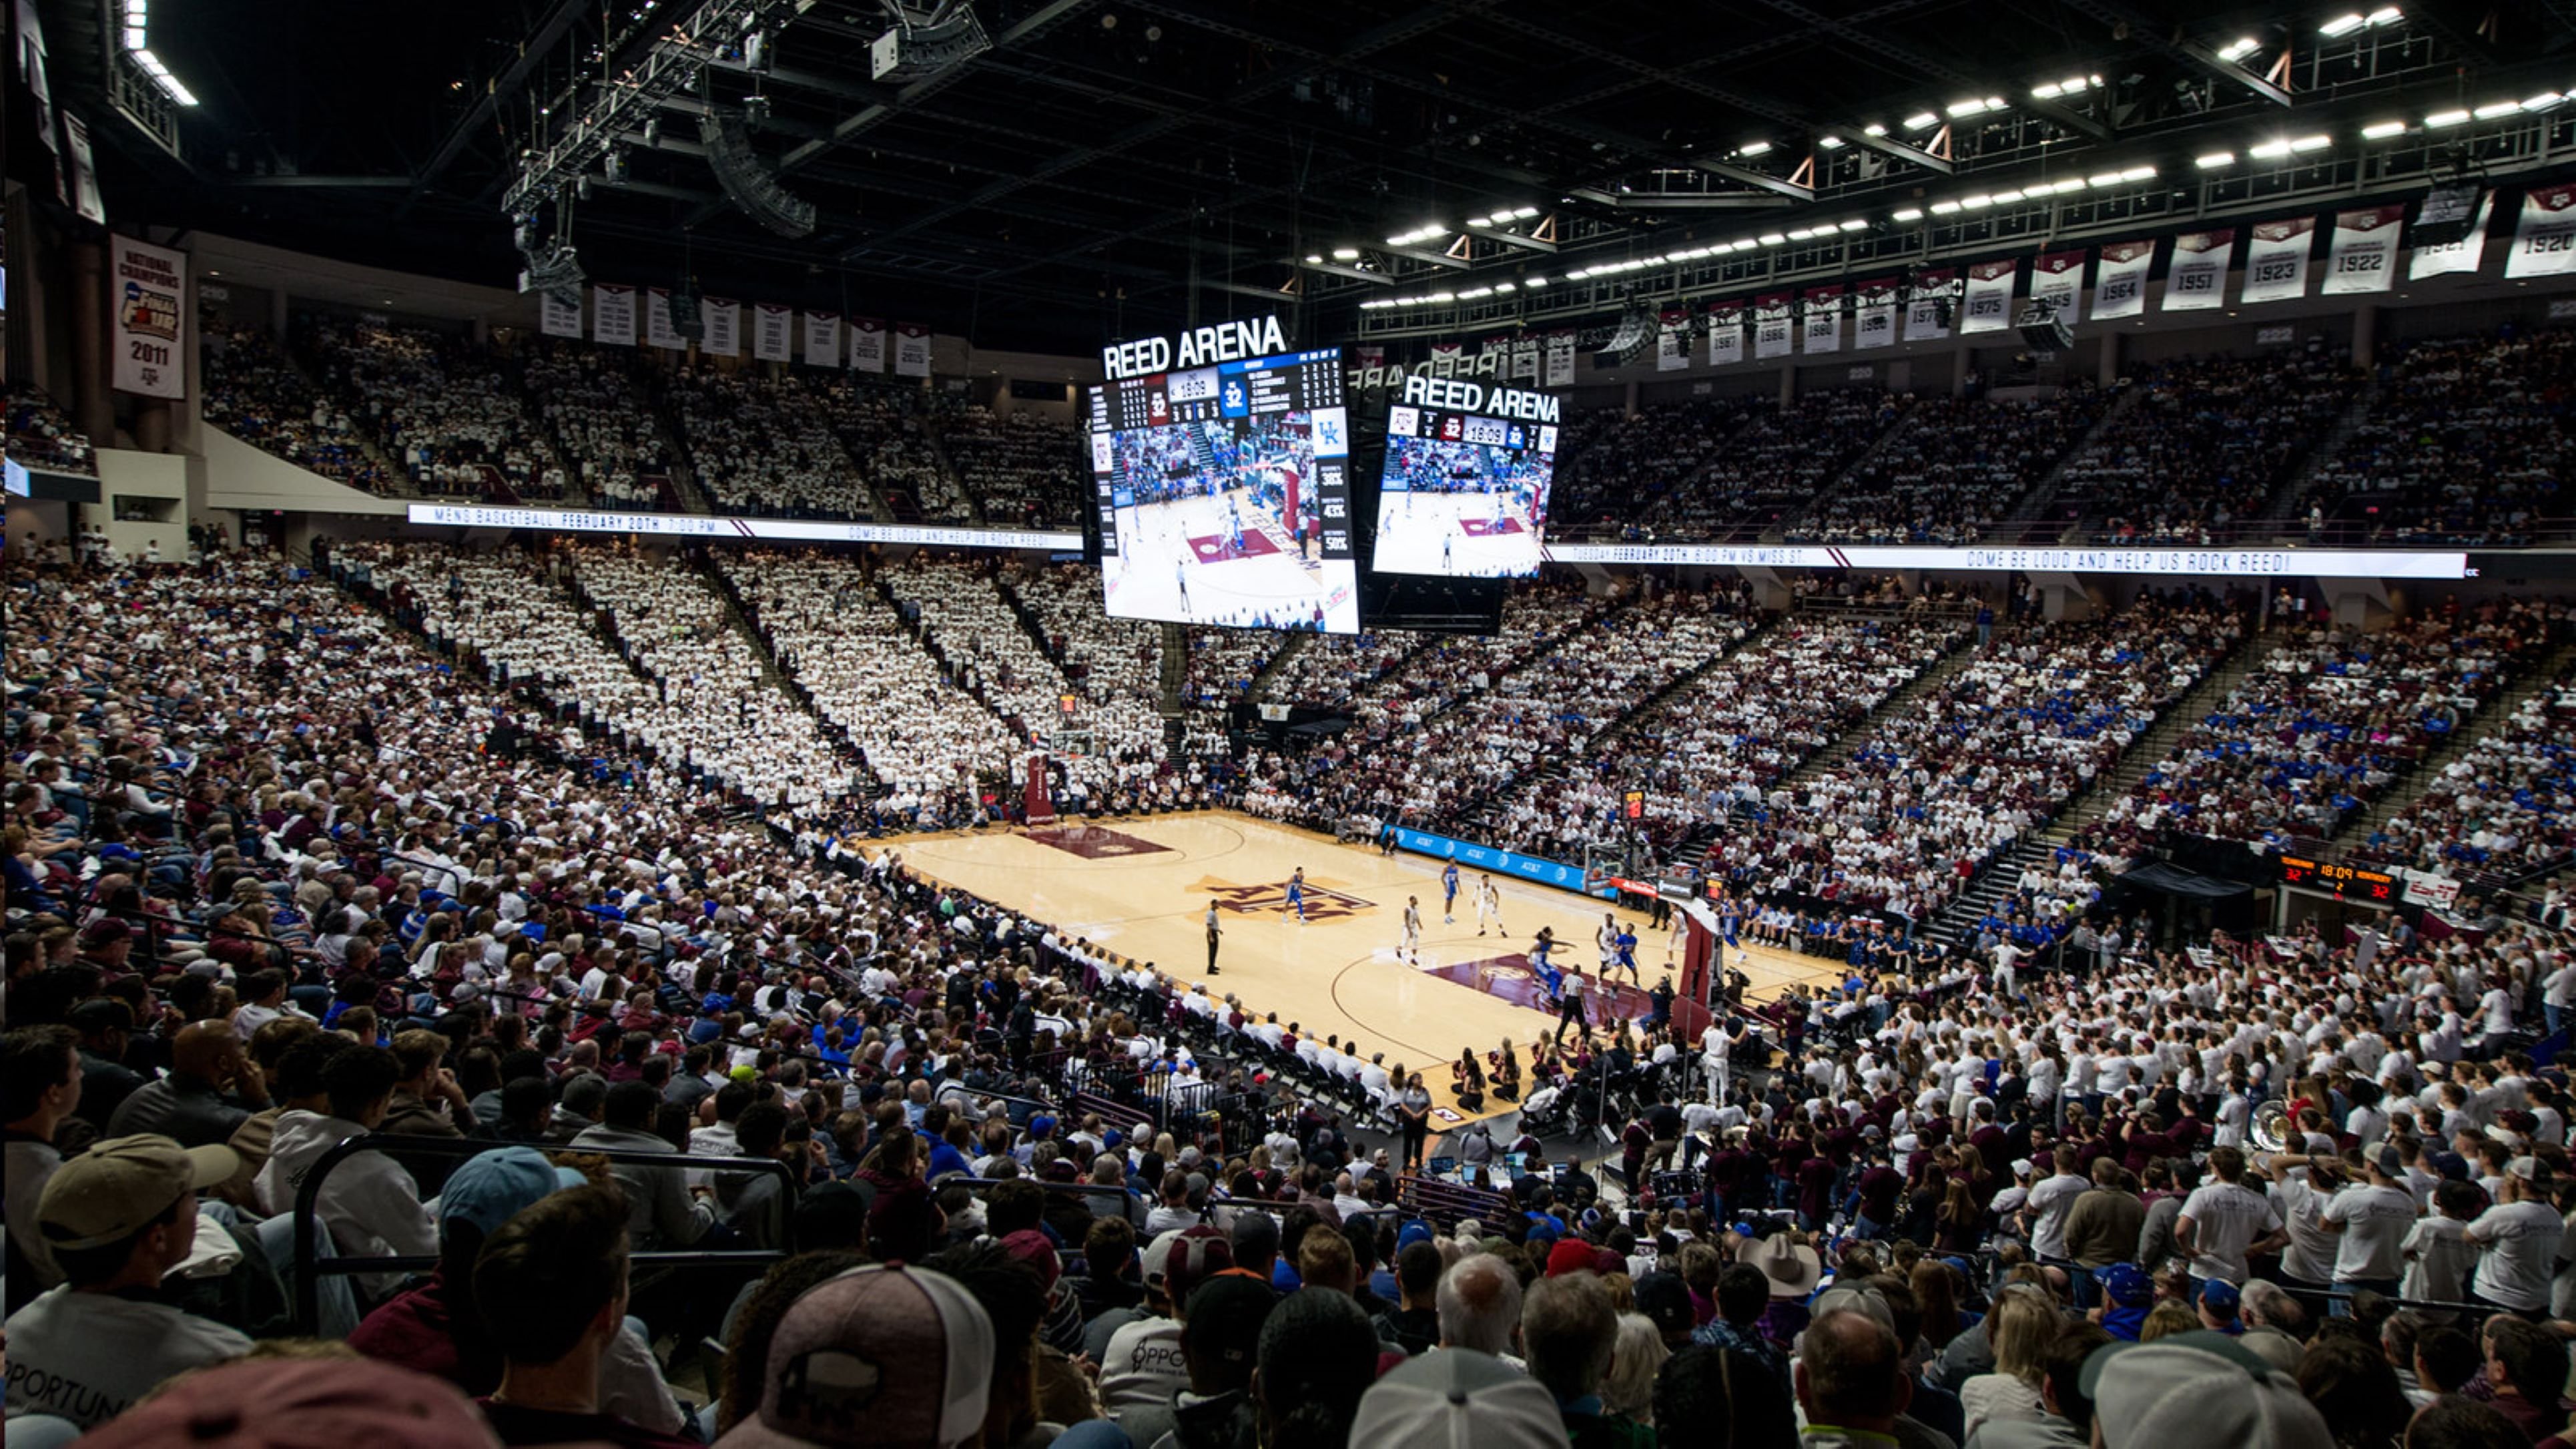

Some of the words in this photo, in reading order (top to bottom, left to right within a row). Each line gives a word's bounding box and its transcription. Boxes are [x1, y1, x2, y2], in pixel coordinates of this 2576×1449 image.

[2525, 234, 2575, 255] 1920
[2254, 262, 2295, 281] 1923
[2338, 254, 2382, 273] 1922
[2178, 274, 2213, 290] 1951
[2102, 284, 2136, 302] 1964
[1969, 298, 2001, 316] 1975
[1912, 309, 1937, 324] 197
[130, 340, 169, 366] 2011
[1103, 336, 1170, 380] REED
[1177, 314, 1286, 368] ARENA
[1225, 387, 1243, 408] 32
[1404, 375, 1483, 412] REED
[1486, 386, 1560, 424] ARENA
[1151, 398, 1167, 417] 32
[1319, 421, 1339, 445] UK
[1444, 424, 1461, 438] 32
[1471, 427, 1502, 443] 18:09
[1509, 431, 1523, 445] 32
[435, 508, 469, 523] MENS
[476, 509, 553, 527] BASKETBALL
[562, 514, 621, 529] FEBRUARY
[629, 517, 659, 531] 20TH
[1613, 548, 1658, 561] FEBRUARY
[1664, 548, 1688, 562] 20TH
[1741, 549, 1754, 563] VS
[1758, 550, 1785, 563] MISS
[1967, 551, 2003, 567] COME
[2011, 551, 2027, 567] BE
[2033, 551, 2070, 569] LOUD
[2078, 552, 2107, 569] AND
[2115, 553, 2151, 571] HELP
[2160, 553, 2180, 571] US
[2188, 553, 2230, 572] ROCK
[2239, 554, 2289, 572] REED!
[1415, 835, 1433, 848] AT&T
[1466, 848, 1486, 860] AT&T
[1521, 861, 1542, 874] AT&T
[2285, 867, 2302, 882] 32
[2320, 864, 2353, 881] 18:09
[2370, 884, 2390, 900] 32
[5, 1359, 128, 1422] PORTUN
